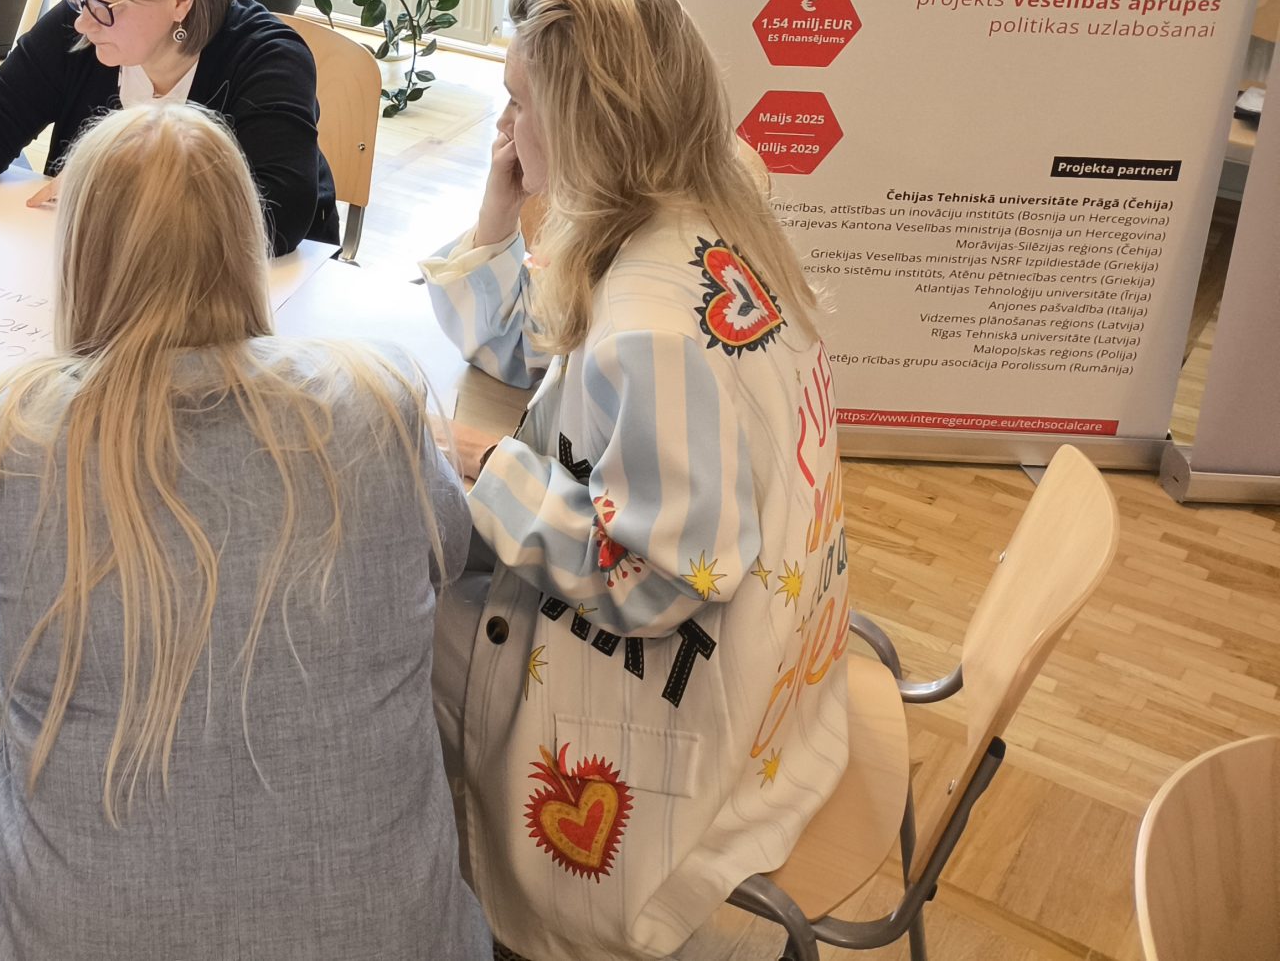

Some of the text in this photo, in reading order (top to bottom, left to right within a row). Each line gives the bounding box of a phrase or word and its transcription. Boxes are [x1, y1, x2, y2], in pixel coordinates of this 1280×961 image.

[761, 17, 853, 33] 1.54 milj.EUR
[988, 16, 1217, 38] politikas uzlabošanai
[767, 33, 845, 45] ES finansējums
[758, 112, 825, 125] Maijs 2025
[755, 141, 820, 154] Jūlijs 2029
[1057, 162, 1173, 177] Projekta partneri
[886, 189, 1174, 212] Čehijas Tehniskā universitāte Prāgā (Čehija)
[771, 203, 1170, 227] niecības, attīstības un inovāciju institūts (Bosnija un Hercegovina)
[841, 219, 892, 232] Kantona
[896, 221, 952, 234] Veselības
[955, 224, 1012, 237] ministrija
[1014, 225, 1063, 239] (Bosnija
[1066, 228, 1082, 238] un
[1085, 228, 1166, 243] Hercegovina)
[955, 239, 1163, 257] Morāvijas-Silēzijas reģions (Čehija)
[810, 248, 1159, 274] Grieķijas Veselības ministrijas NSRF Izpildiestāde (Grieķija)
[802, 264, 841, 275] ecisko
[844, 265, 892, 277] sistēmu
[894, 267, 946, 280] institūts,
[949, 269, 985, 281] Atēnu
[988, 271, 1057, 285] pētniecības
[1060, 274, 1098, 285] centrs
[915, 283, 1152, 303] Atlantijas Tehnoloģiju universitāte (Īrija)
[988, 300, 1149, 318] Anjones pašvaldība (Itālija)
[920, 312, 1145, 333] Vidzemes plānošanas reģions (Latvija)
[930, 327, 1141, 348] Rīgas Tehniskā universitāte (Latvija)
[829, 354, 1134, 376] etējo rīcības grupu asociācija Porolissum (Rumānija)
[1049, 347, 1093, 360] reģions
[1096, 348, 1137, 362] (Polija)
[835, 410, 1103, 431] https://www.interregeurope.eu/techsocialcare
